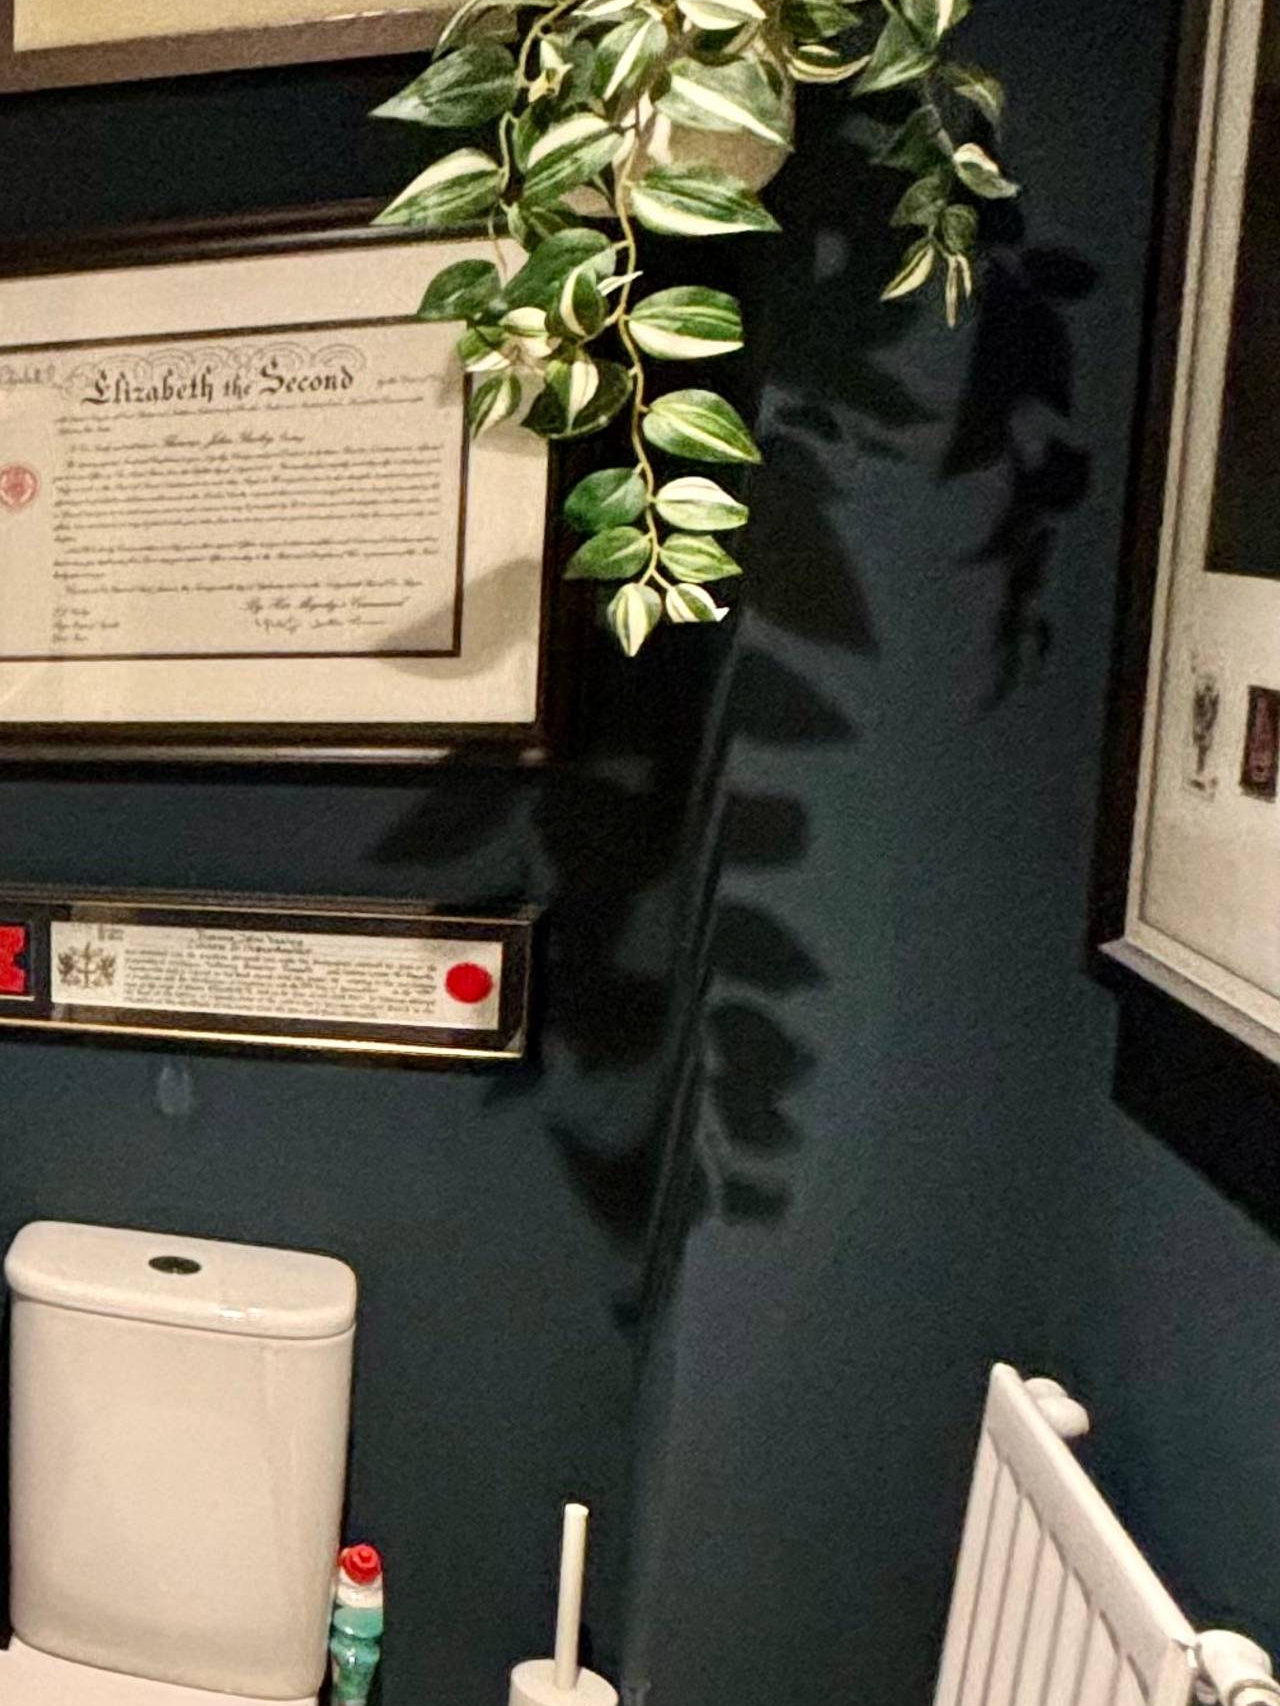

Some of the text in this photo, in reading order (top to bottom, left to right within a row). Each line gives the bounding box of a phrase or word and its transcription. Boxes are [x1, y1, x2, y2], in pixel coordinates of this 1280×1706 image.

[81, 364, 214, 405] Elizabeth
[223, 372, 252, 400] the
[258, 355, 354, 395] Second
